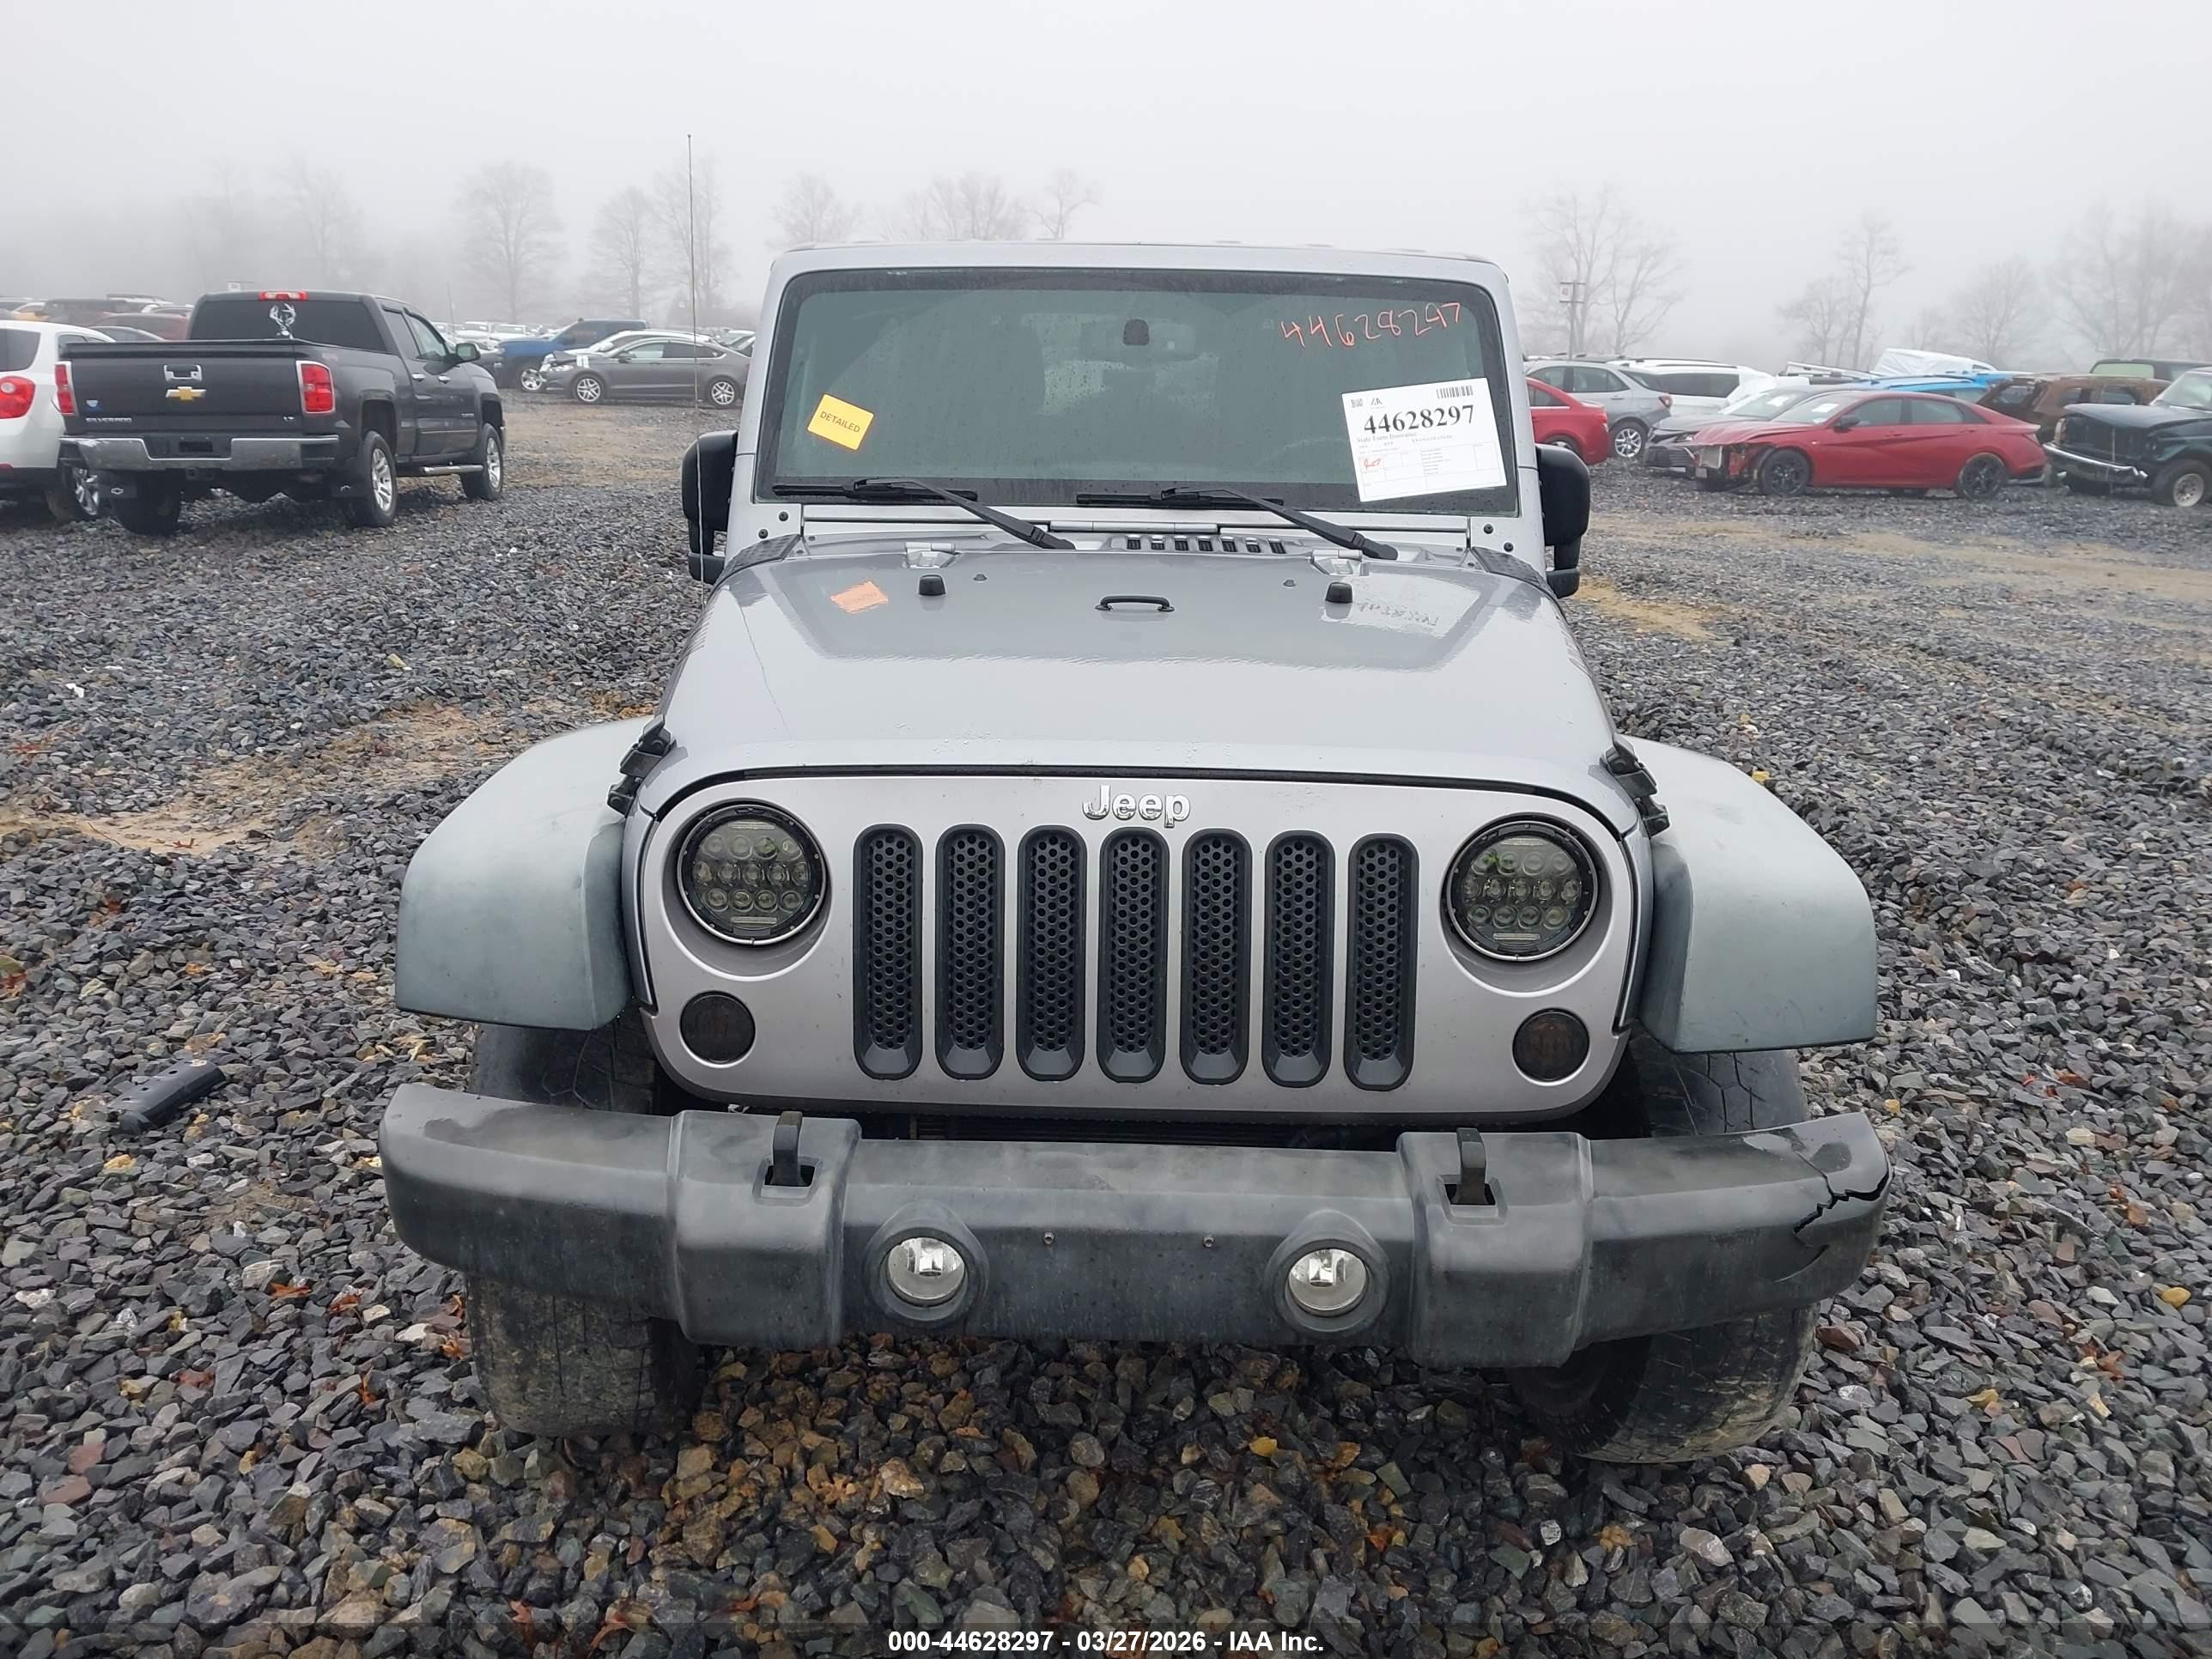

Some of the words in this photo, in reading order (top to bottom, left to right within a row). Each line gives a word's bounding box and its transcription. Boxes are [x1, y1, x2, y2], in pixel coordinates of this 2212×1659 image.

[1280, 302, 1461, 348] 44628297
[820, 411, 860, 433] DETAILED
[1364, 404, 1474, 434] 44628297
[1082, 784, 1190, 828] Jeep
